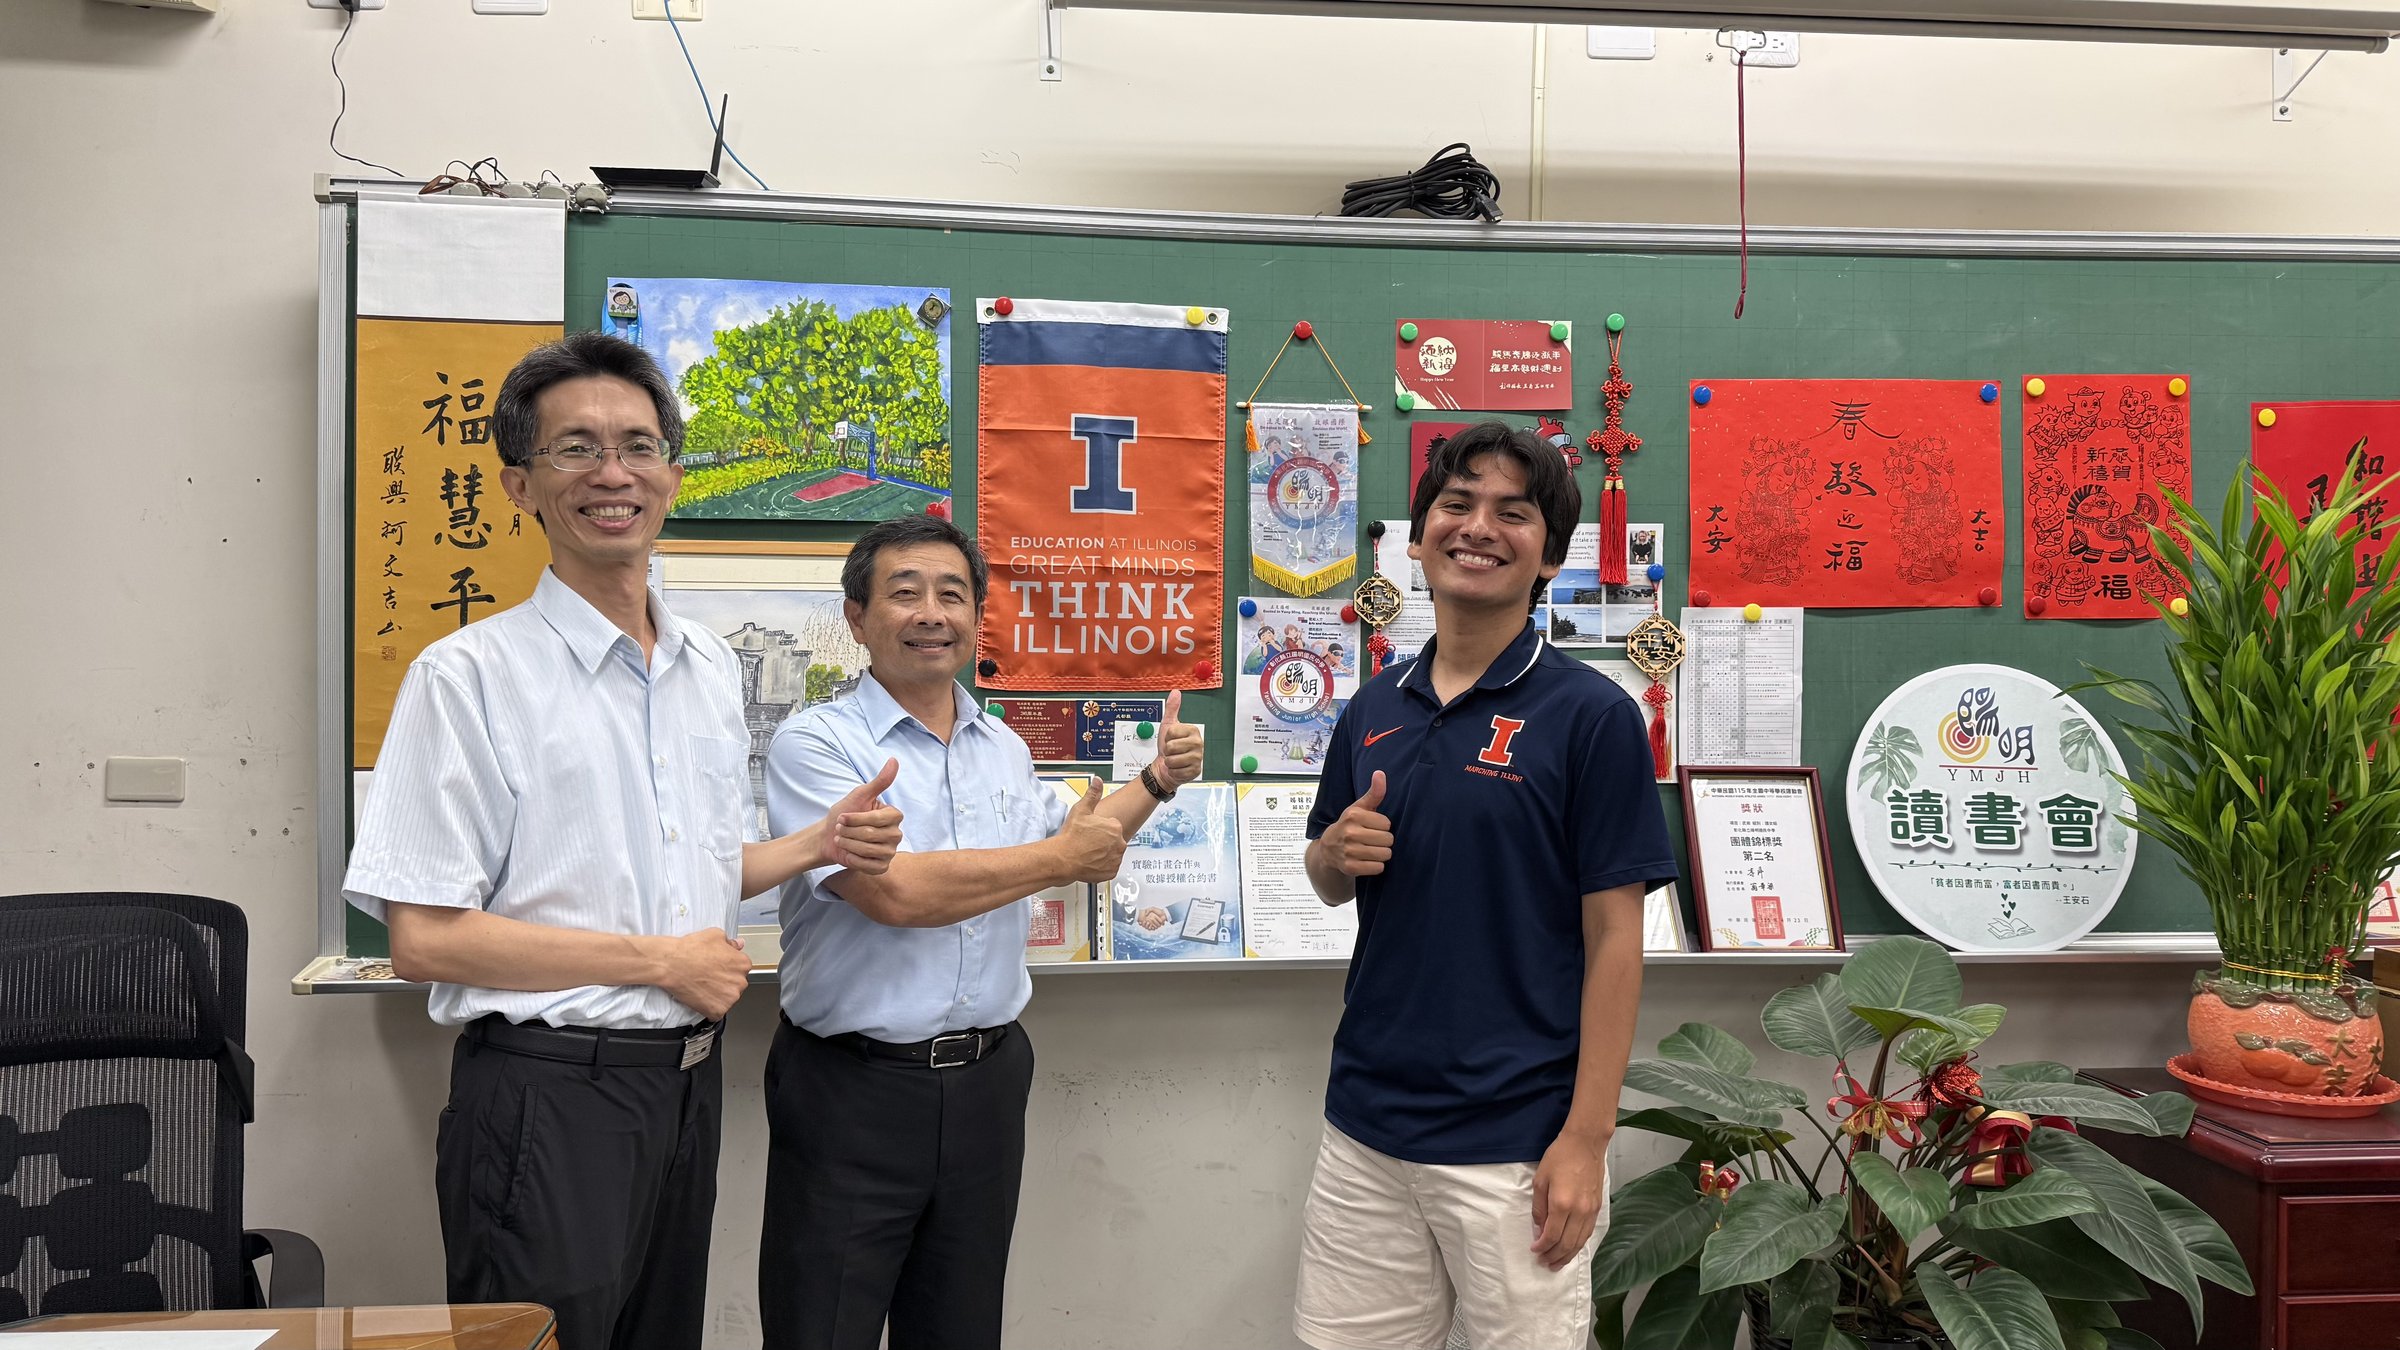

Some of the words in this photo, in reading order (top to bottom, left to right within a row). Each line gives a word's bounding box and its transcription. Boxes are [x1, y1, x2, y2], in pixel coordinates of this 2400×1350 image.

[1070, 413, 1137, 515] I
[1702, 504, 1735, 553] 大安
[1011, 537, 1104, 549] EDUCATION
[1110, 538, 1127, 550] AT
[1133, 539, 1197, 551] ILLINOIS
[1010, 555, 1100, 575] GREAT
[1111, 556, 1195, 576] MINDS
[2094, 574, 2131, 600] 福
[1010, 581, 1194, 620] THINK
[1013, 624, 1195, 654] ILLINOIS
[1637, 633, 1674, 660] 平安
[1478, 715, 1525, 767] I
[1465, 764, 1498, 777] MARCHING
[1500, 771, 1524, 783] ILLINI
[1886, 789, 2103, 848] 讀書會
[1131, 859, 1201, 870] 實驗計畫合作與
[1742, 851, 1774, 862] 第二名
[1145, 873, 1218, 884] 數據授權合約書
